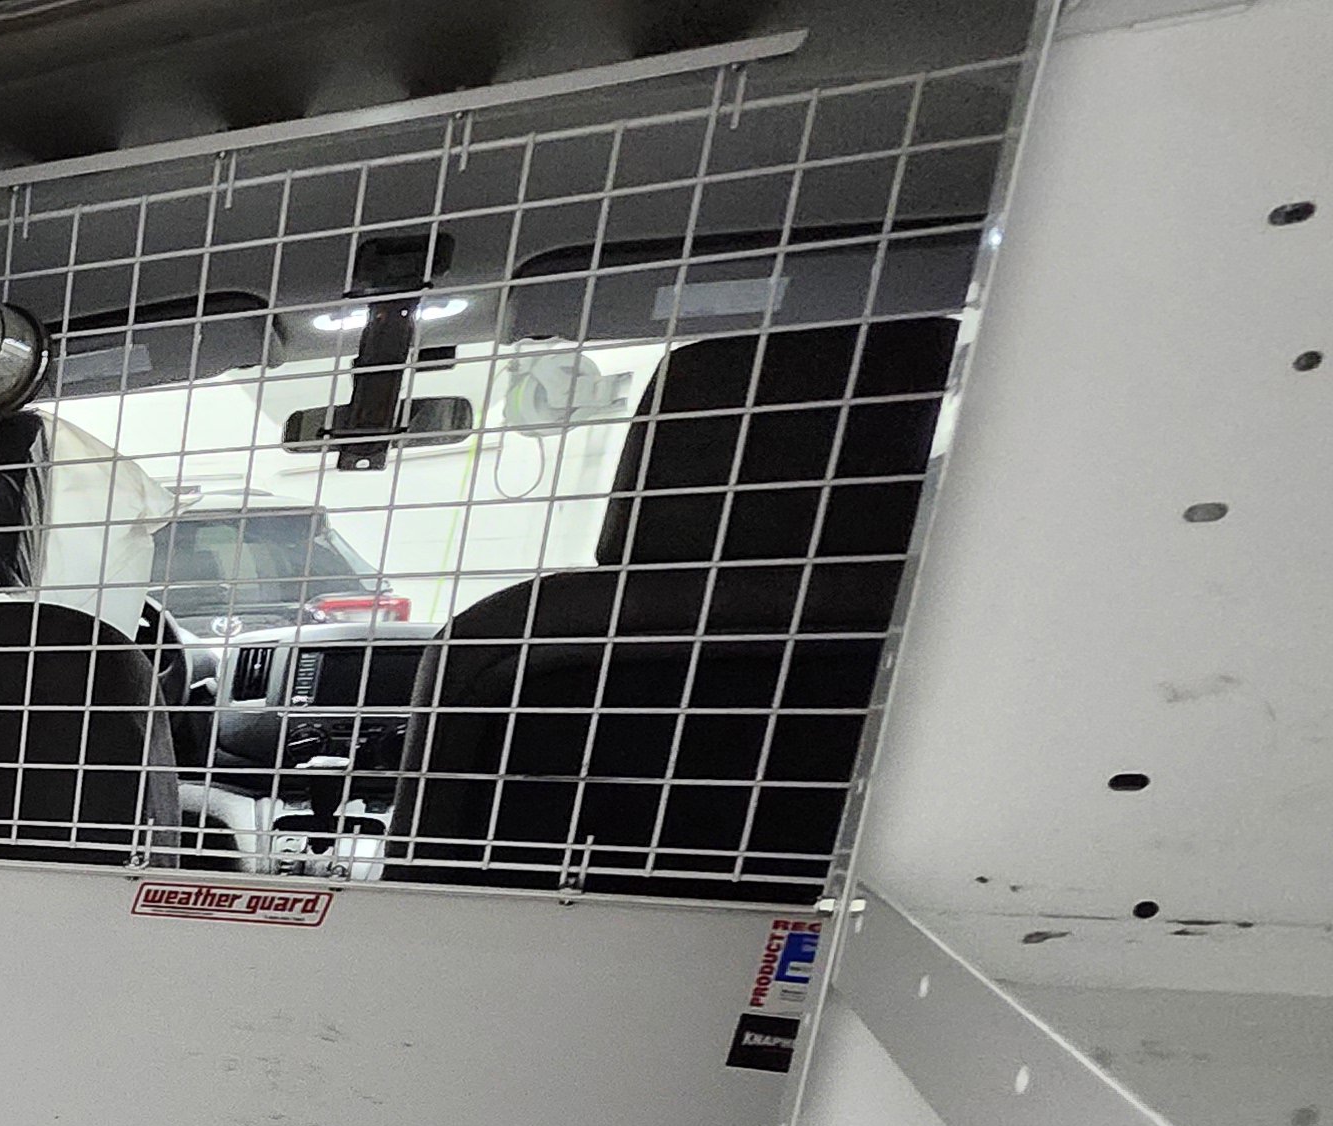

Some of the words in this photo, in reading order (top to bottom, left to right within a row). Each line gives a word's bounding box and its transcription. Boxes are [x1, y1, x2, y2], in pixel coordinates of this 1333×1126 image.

[143, 888, 243, 909] weather
[246, 893, 320, 914] guard
[749, 932, 785, 1007] PRODUCT
